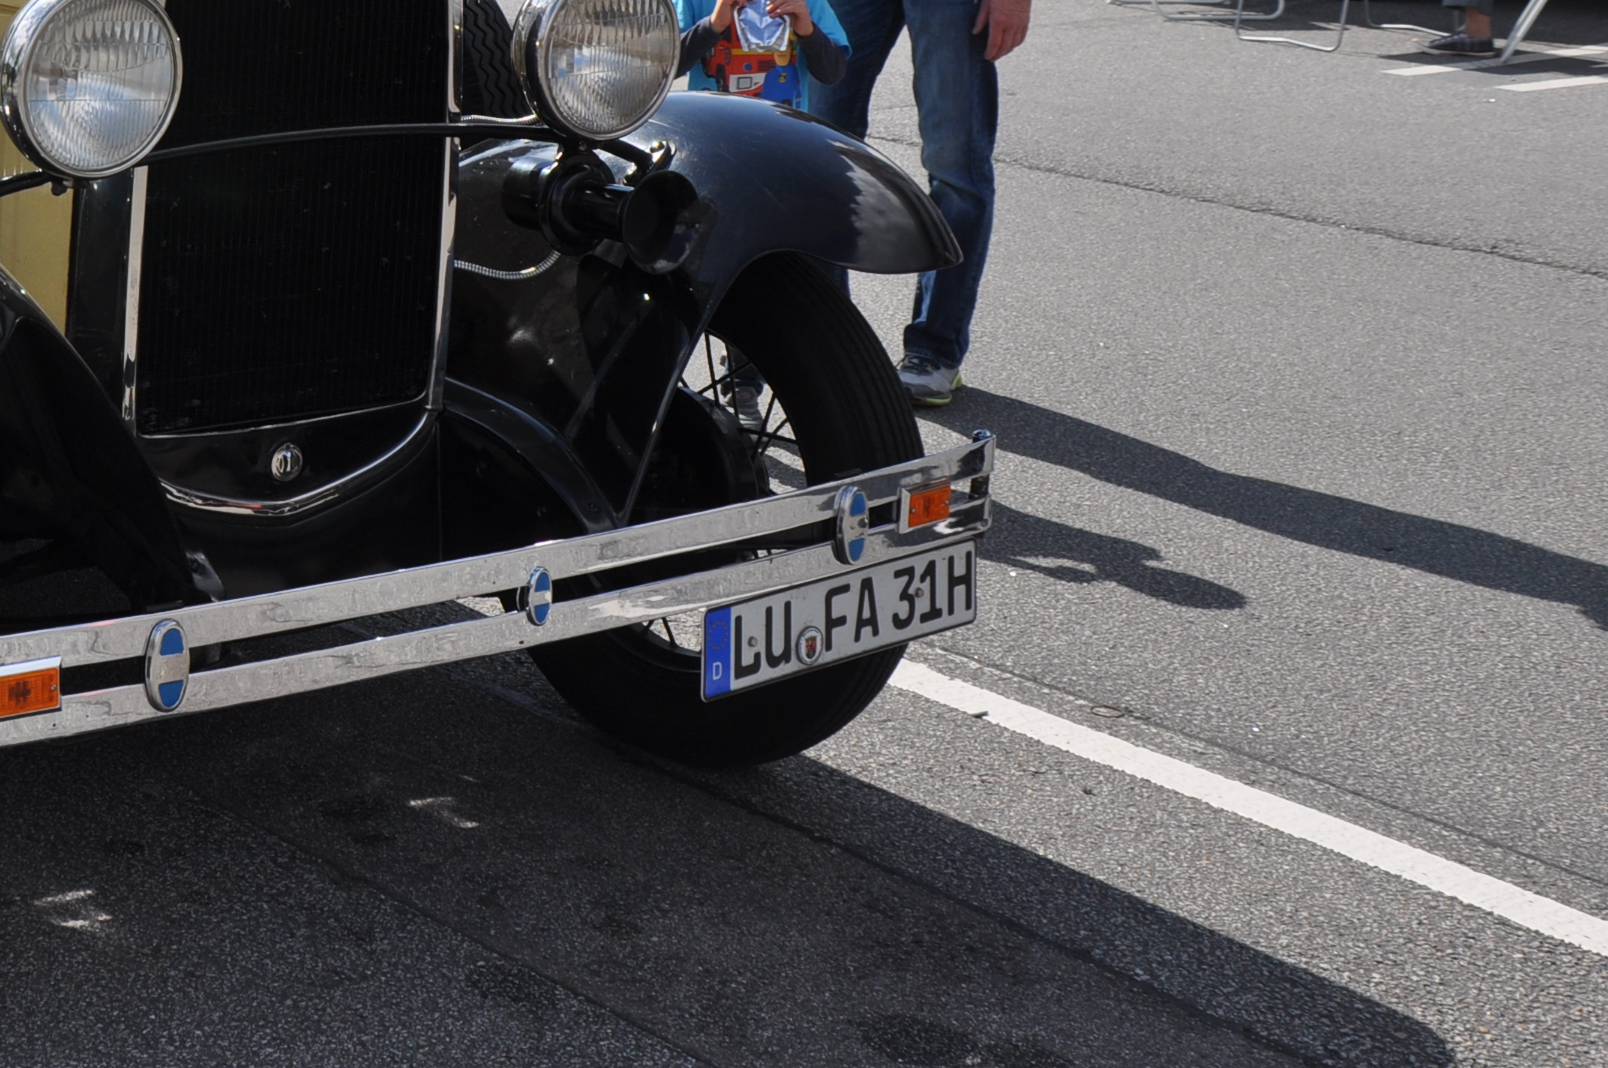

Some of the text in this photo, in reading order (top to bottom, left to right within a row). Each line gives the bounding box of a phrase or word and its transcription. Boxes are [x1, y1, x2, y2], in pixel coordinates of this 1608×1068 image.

[734, 550, 973, 680] LU FA 31H
[712, 662, 723, 681] D
